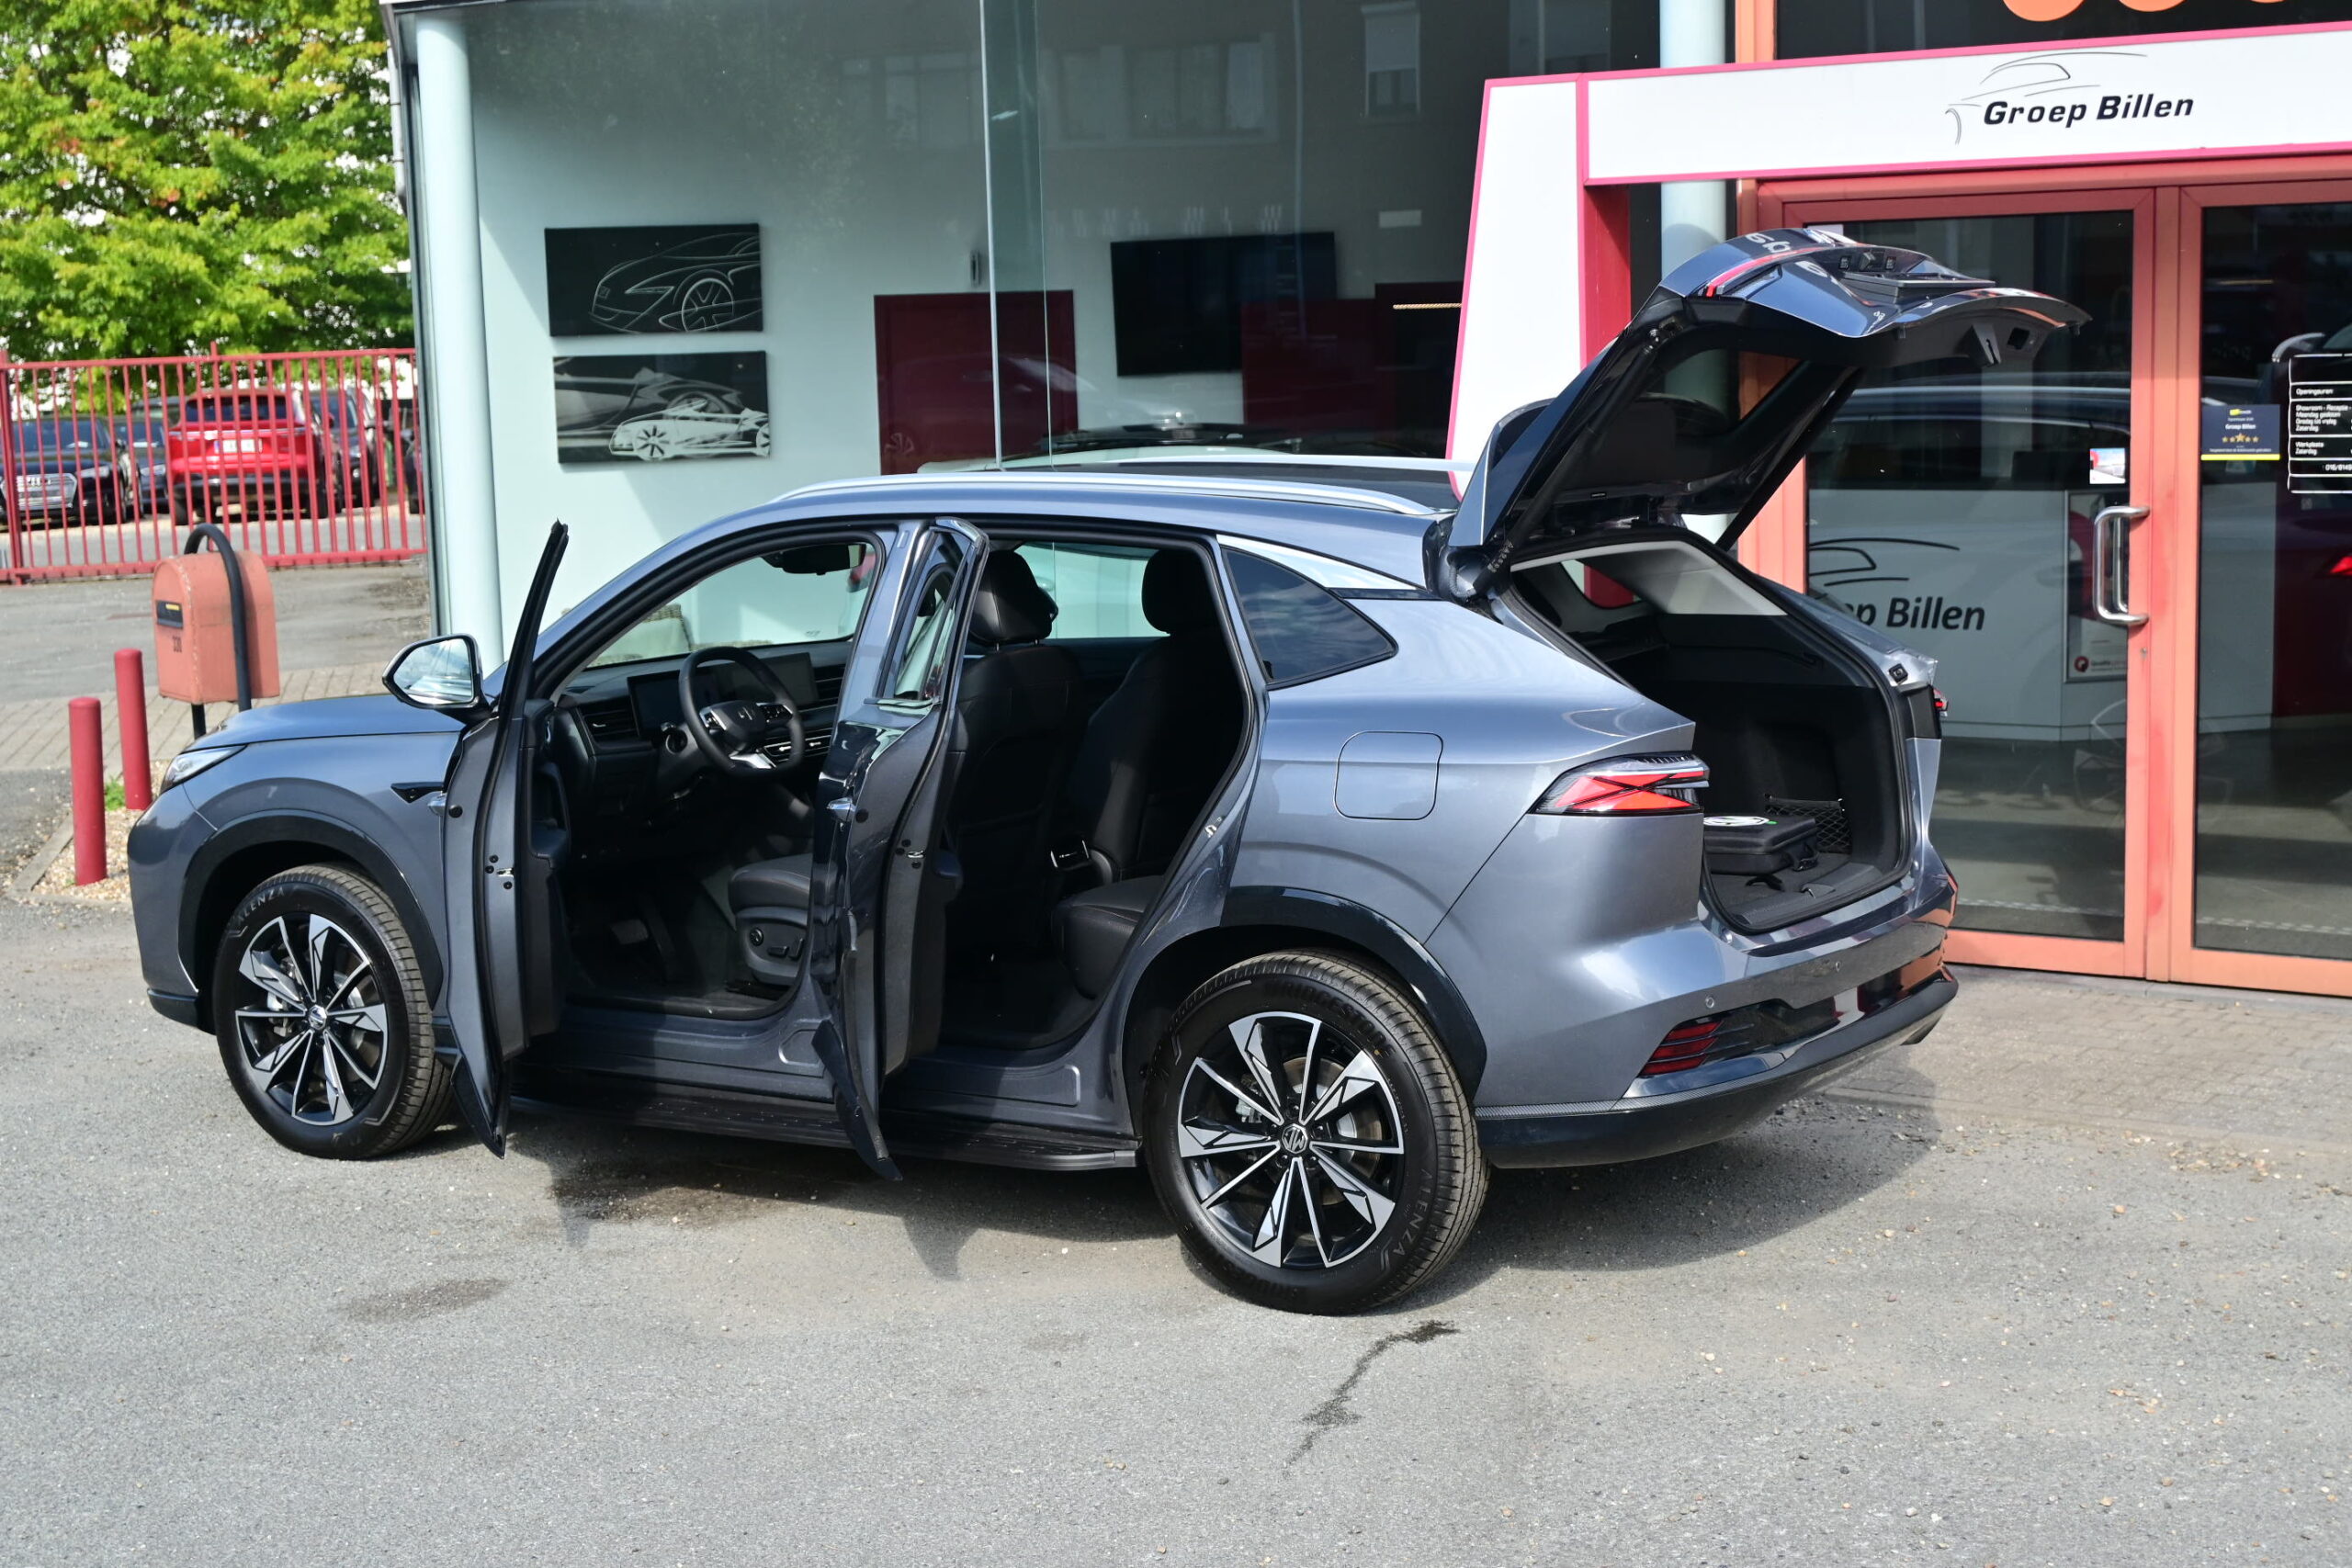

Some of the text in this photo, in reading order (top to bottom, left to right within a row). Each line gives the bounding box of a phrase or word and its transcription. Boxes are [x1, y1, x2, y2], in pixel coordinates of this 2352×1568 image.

[1984, 94, 2194, 128] Groep Billen
[1886, 596, 1985, 630] Billen
[1393, 1168, 1433, 1257] ALENZA
